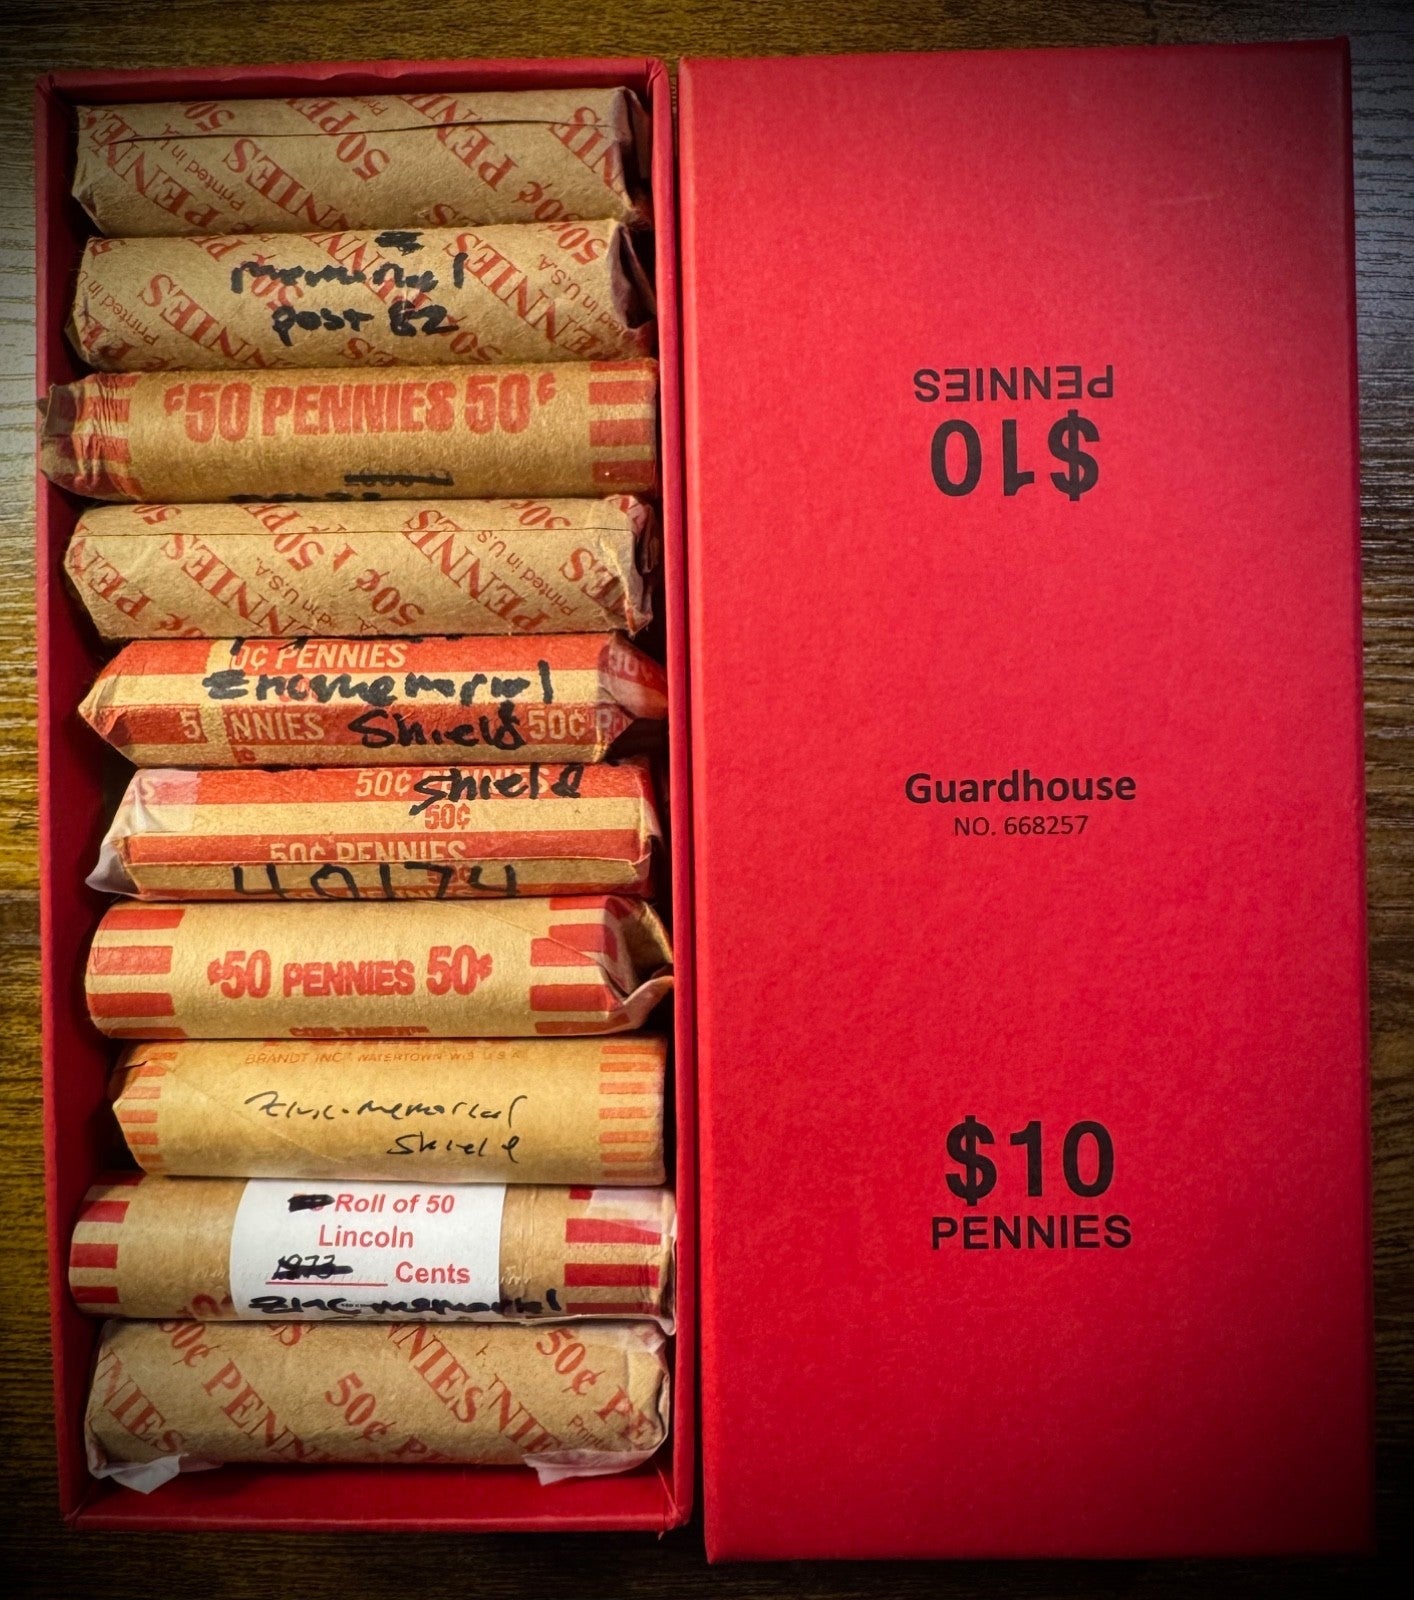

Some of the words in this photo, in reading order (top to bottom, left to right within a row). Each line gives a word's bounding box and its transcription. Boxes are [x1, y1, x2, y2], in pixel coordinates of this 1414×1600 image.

[186, 162, 246, 212] Printed
[101, 292, 160, 347] Printed
[912, 364, 1114, 403] PENNIES
[261, 379, 458, 437] PENNIES
[930, 409, 1101, 503] $10
[347, 567, 425, 629] 50¢
[275, 643, 406, 671] PENNIES
[527, 709, 586, 741] 50¢
[355, 770, 412, 797] 50¢
[904, 769, 1137, 804] Guardhouse
[424, 802, 471, 831] 50¢
[954, 816, 997, 837] NO.
[1004, 815, 1089, 836] 668257
[282, 959, 415, 998] PENNIES
[945, 1115, 1115, 1207] $10
[335, 1193, 385, 1213] Roll
[392, 1193, 417, 1213] of
[426, 1194, 455, 1214] 50
[318, 1225, 414, 1248] Lincoln
[931, 1214, 1132, 1251] PENNIES
[395, 1261, 471, 1285] Cents
[325, 1372, 397, 1442] 50¢
